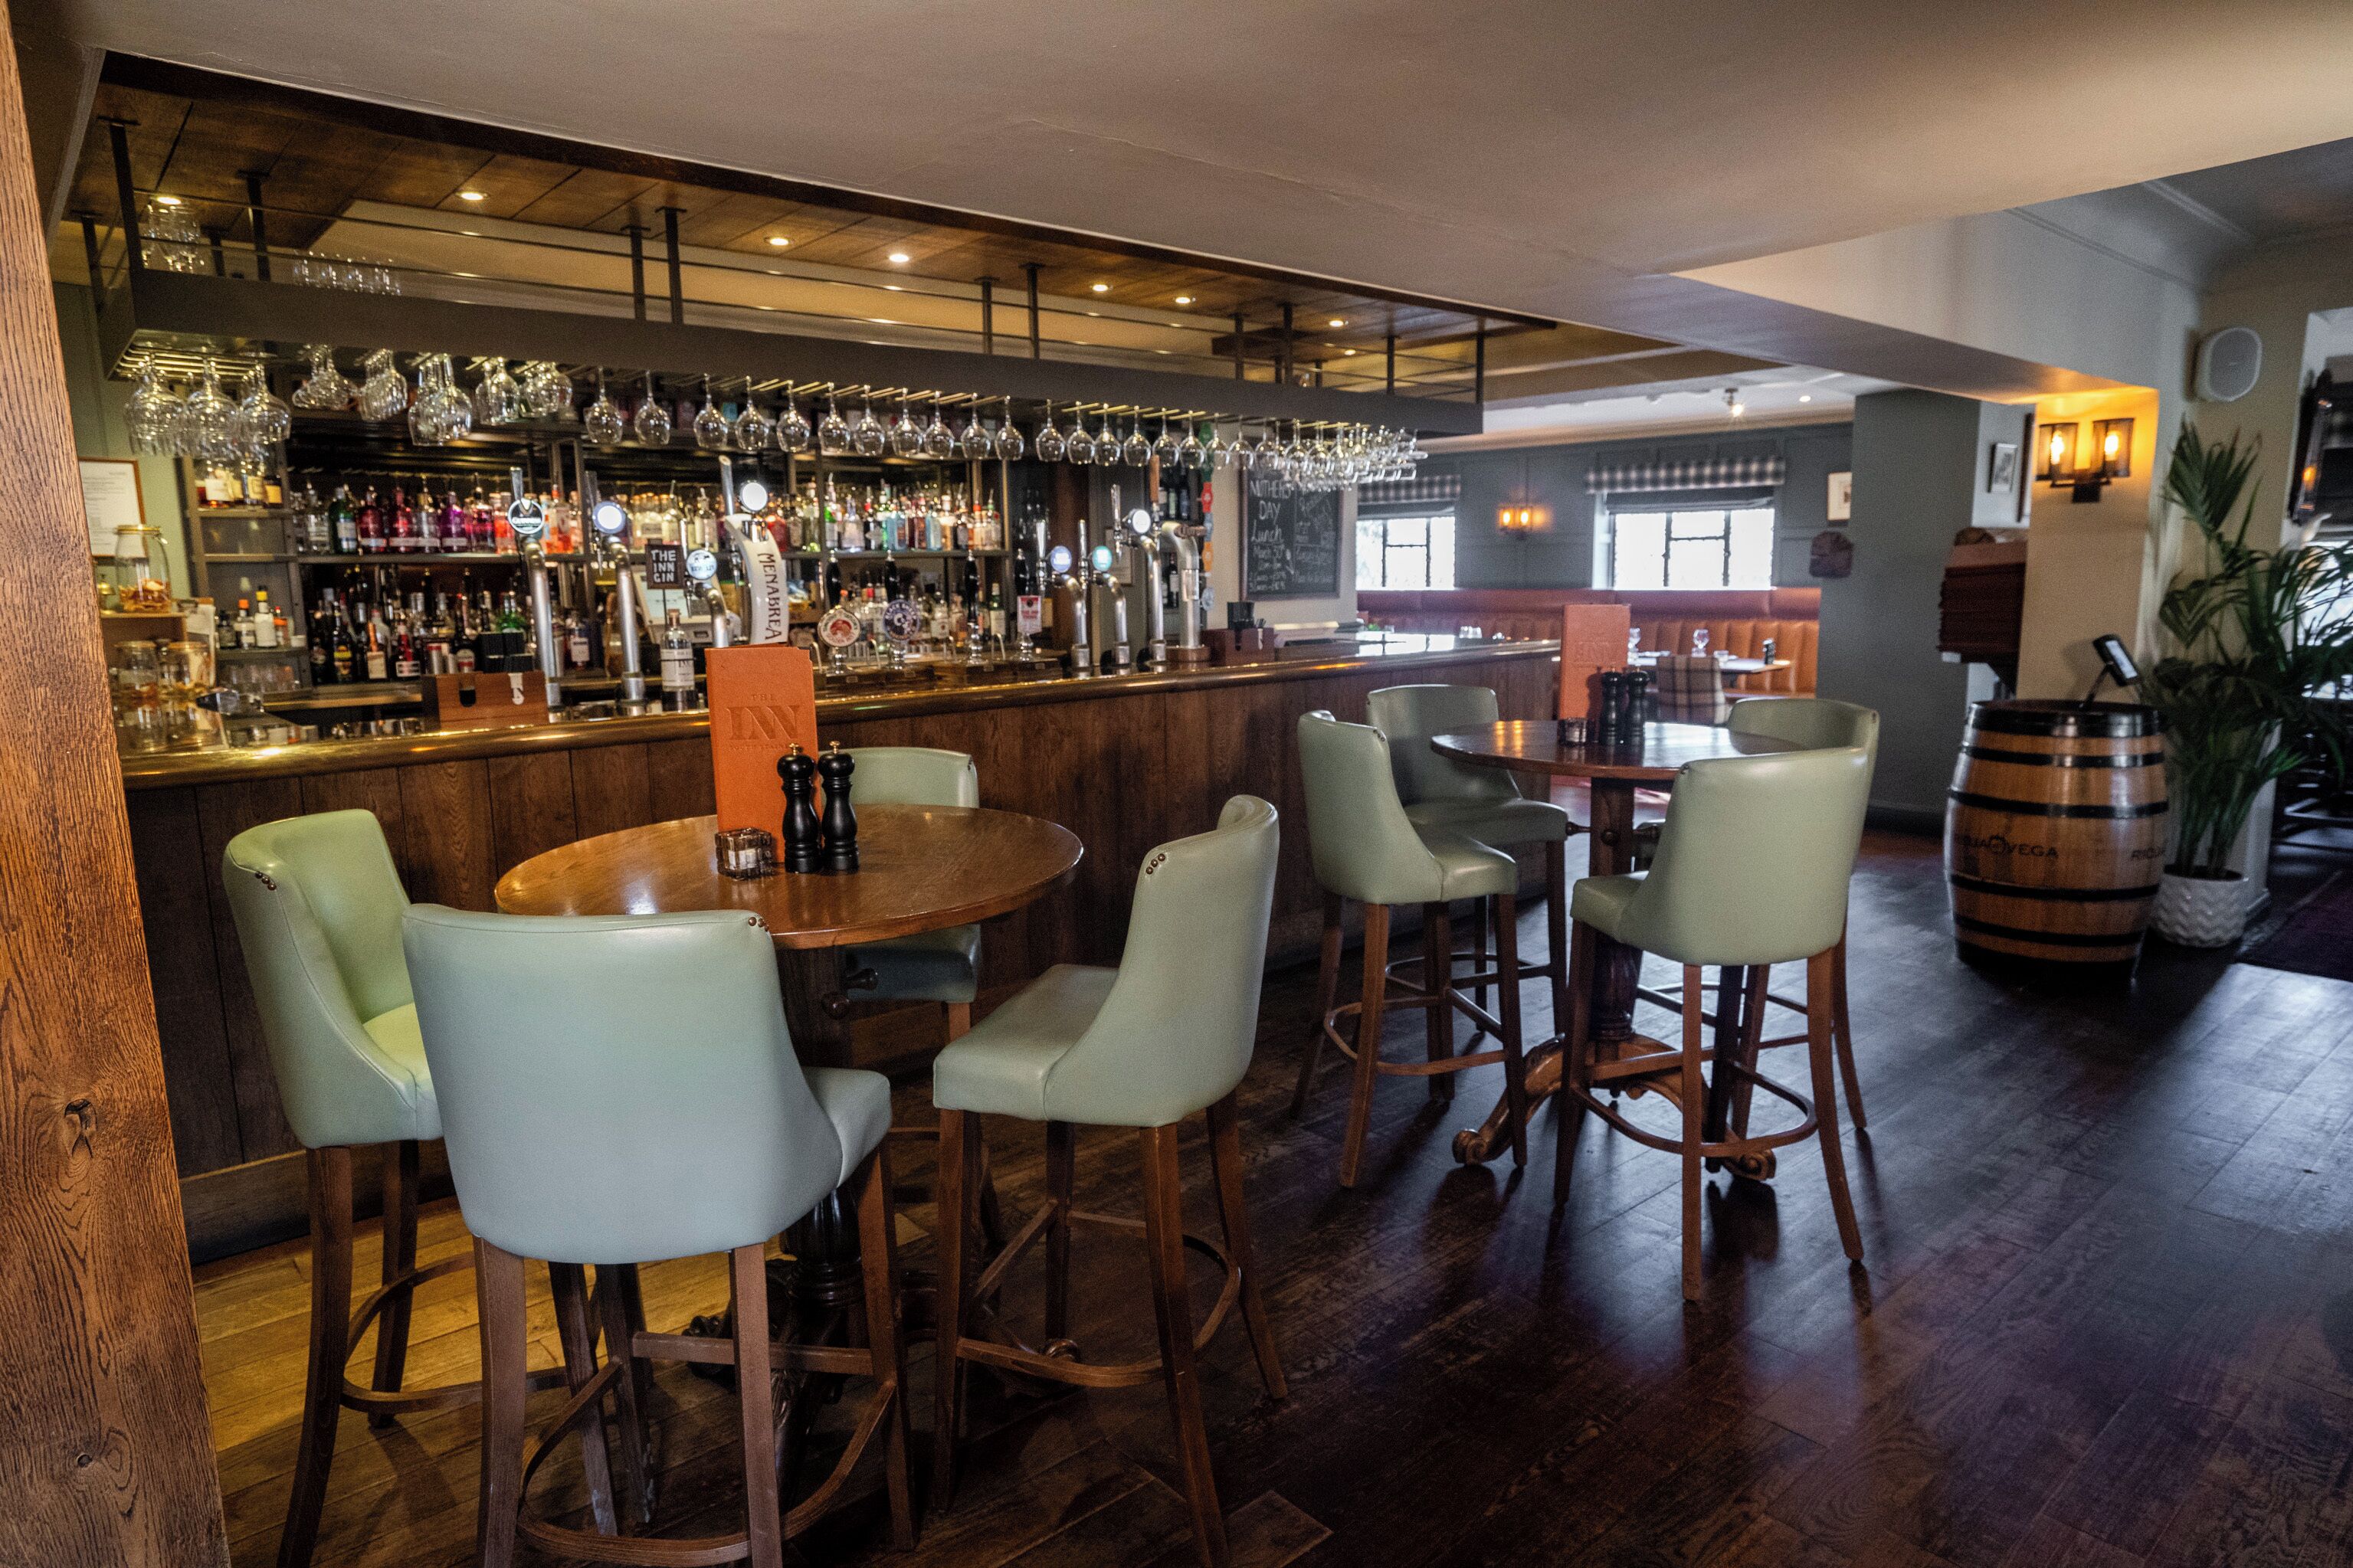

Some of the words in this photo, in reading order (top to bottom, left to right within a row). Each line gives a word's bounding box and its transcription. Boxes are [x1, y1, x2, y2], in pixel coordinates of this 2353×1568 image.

[1259, 500, 1281, 525] DAY
[1250, 519, 1284, 542] Lunch
[651, 549, 677, 561] THE
[654, 561, 675, 573] INN
[654, 572, 674, 584] GIN
[757, 552, 782, 640] MENABREA
